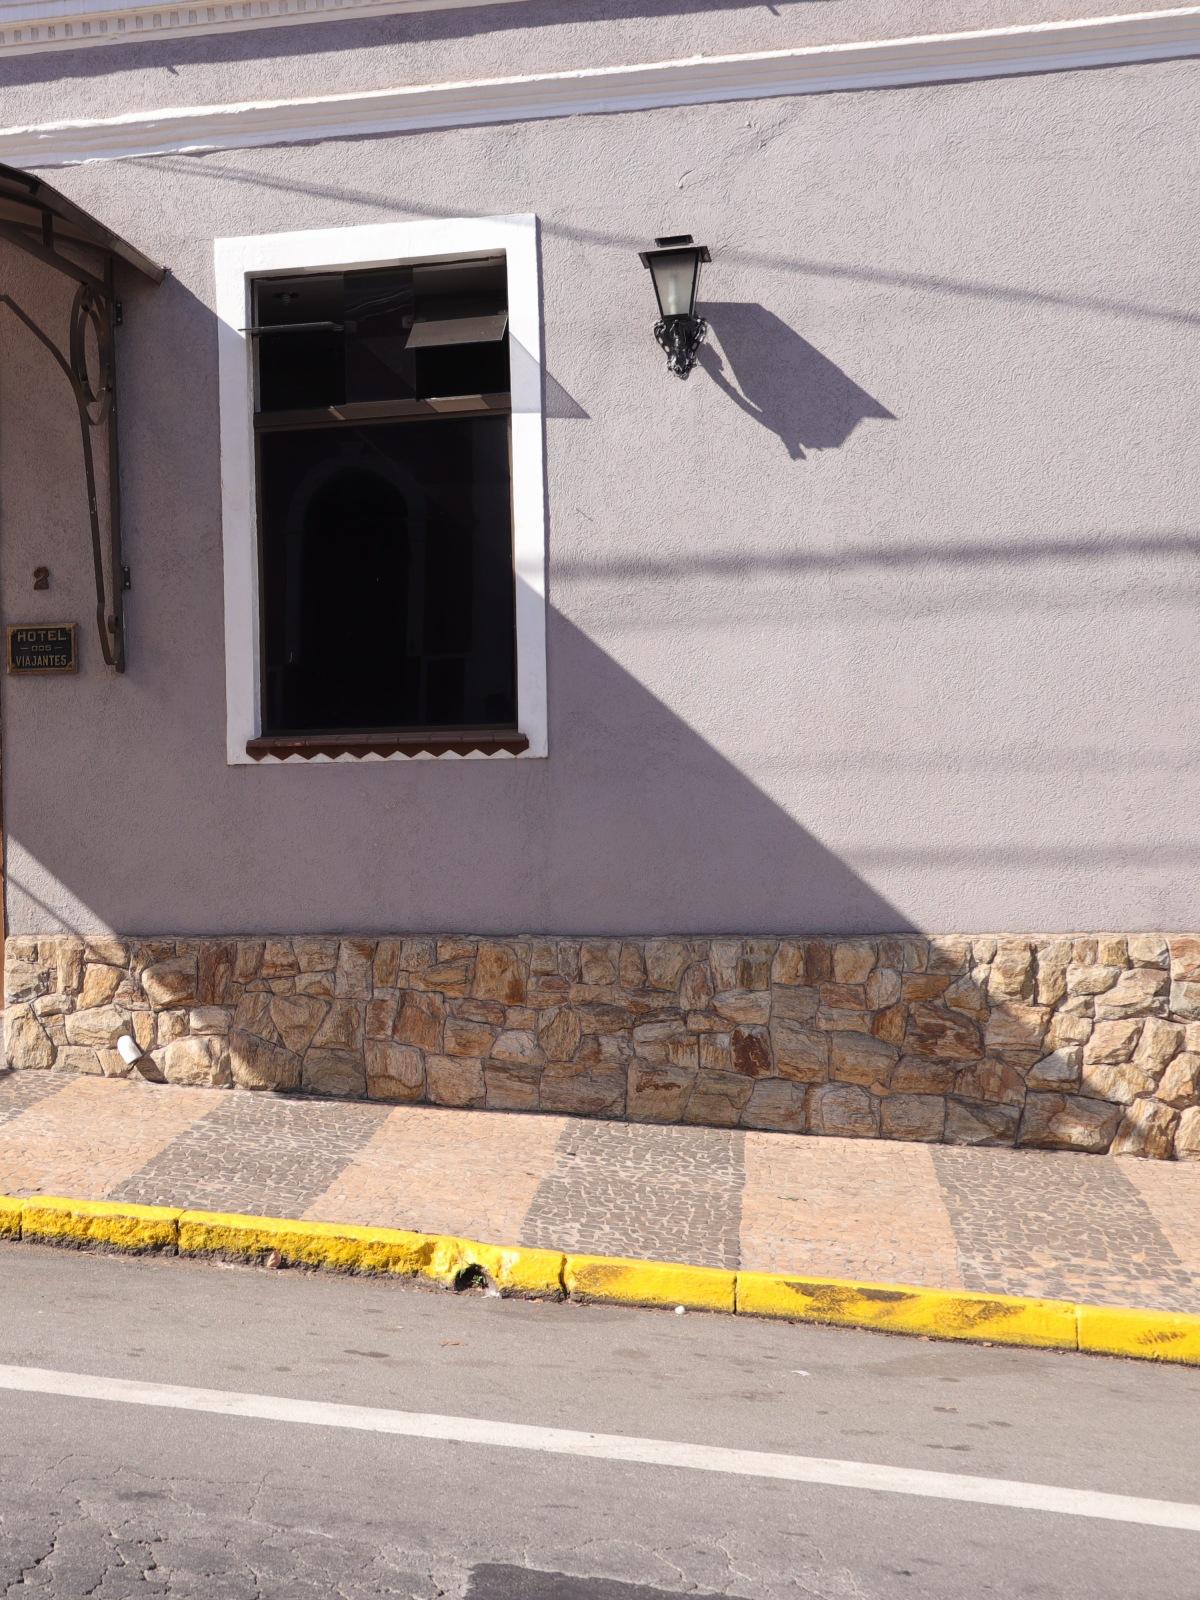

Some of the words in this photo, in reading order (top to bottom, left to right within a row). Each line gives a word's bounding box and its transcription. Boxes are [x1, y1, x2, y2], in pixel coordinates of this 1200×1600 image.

[34, 567, 49, 590] 2
[17, 630, 66, 641] HOTEL
[16, 655, 66, 666] VIAJANTES
